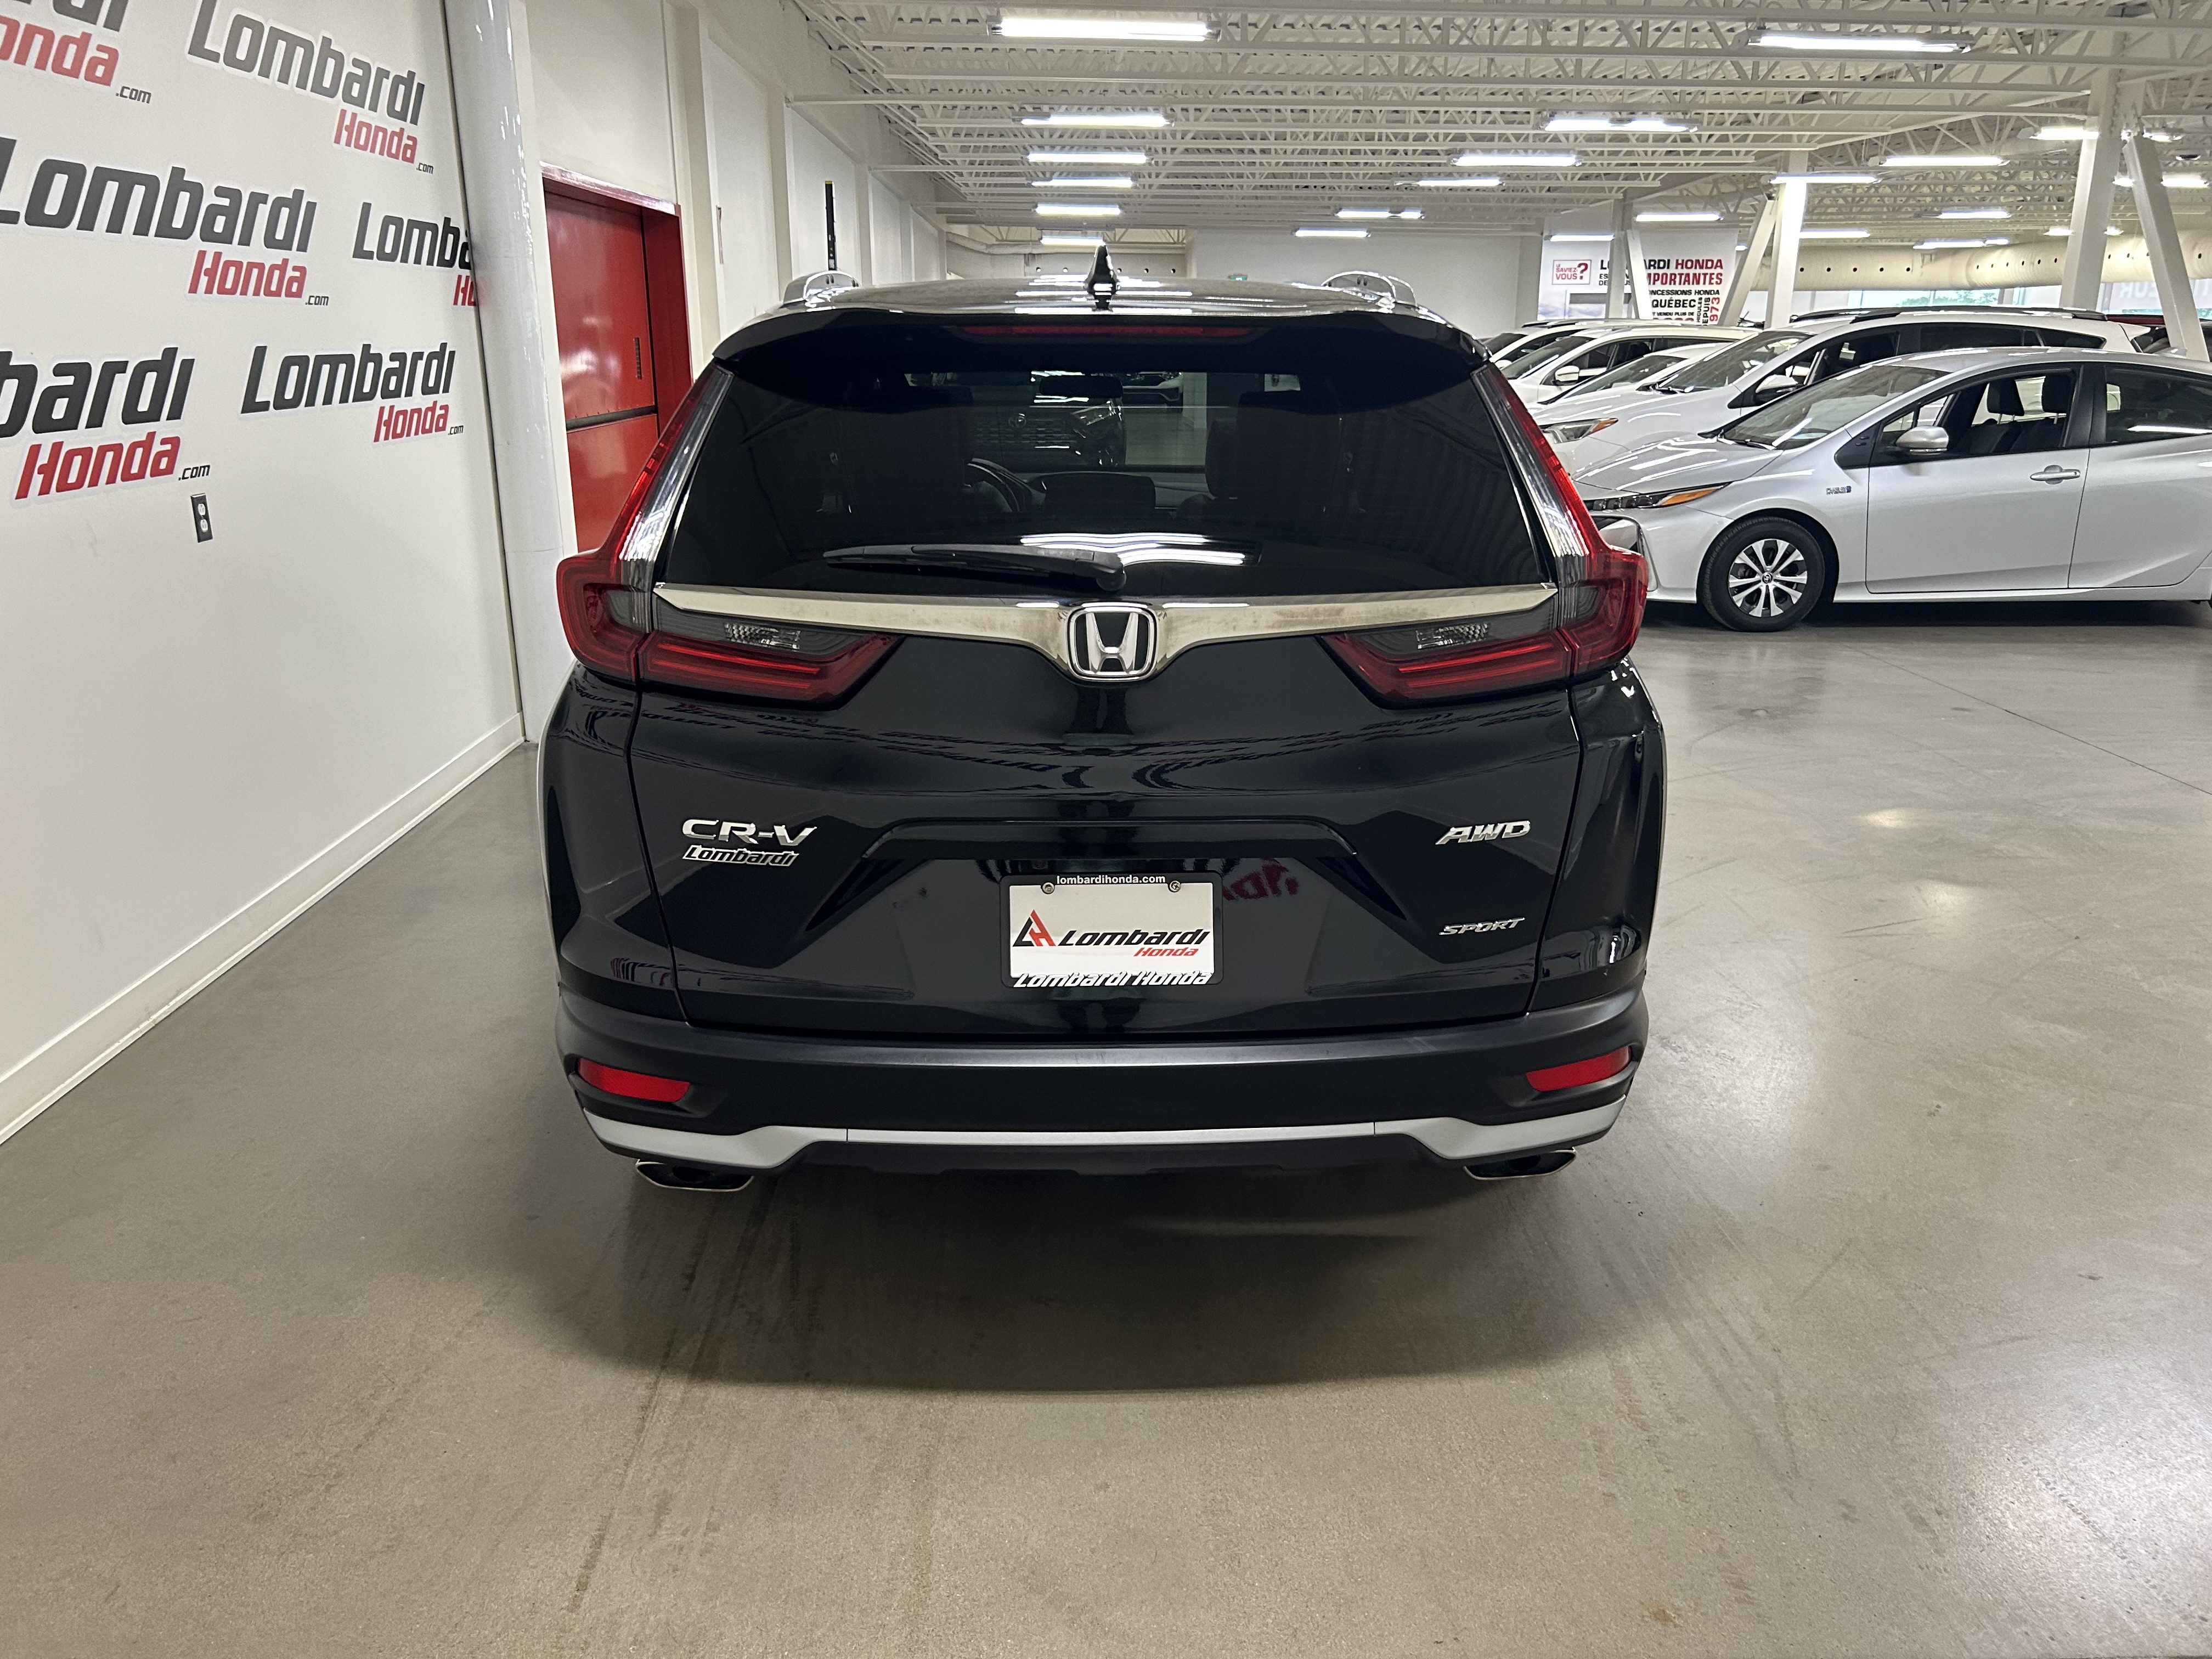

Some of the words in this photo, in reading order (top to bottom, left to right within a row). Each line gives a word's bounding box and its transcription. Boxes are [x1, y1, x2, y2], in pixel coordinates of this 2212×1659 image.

[0, 15, 119, 87] onda
[188, 0, 425, 126] Lombardi
[116, 86, 151, 104] .com
[334, 109, 418, 164] Honda
[416, 162, 433, 174] .com
[352, 202, 472, 270] Lomb
[188, 250, 307, 298] Honda
[1675, 259, 1723, 269] HONDA
[1647, 273, 1723, 285] PORTANTES
[306, 295, 329, 306] .com
[1652, 297, 1696, 308] QUÉBEC
[1709, 297, 1720, 322] 973
[241, 342, 456, 414] Lombardi
[0, 347, 195, 438] bardi
[374, 401, 449, 443] Honda
[448, 424, 464, 435] .com
[15, 431, 180, 500] Honda
[178, 464, 211, 481] .com
[682, 819, 817, 846] CR-V
[1435, 820, 1531, 845] AWD
[682, 845, 799, 867] Lombardi
[1057, 875, 1166, 885] lombardihonda.com
[1438, 917, 1525, 935] SPORT
[1058, 929, 1210, 946] Lombardi
[1133, 947, 1199, 956] Honda
[1014, 970, 1135, 988] Lombardi
[1131, 970, 1213, 986] Honda
